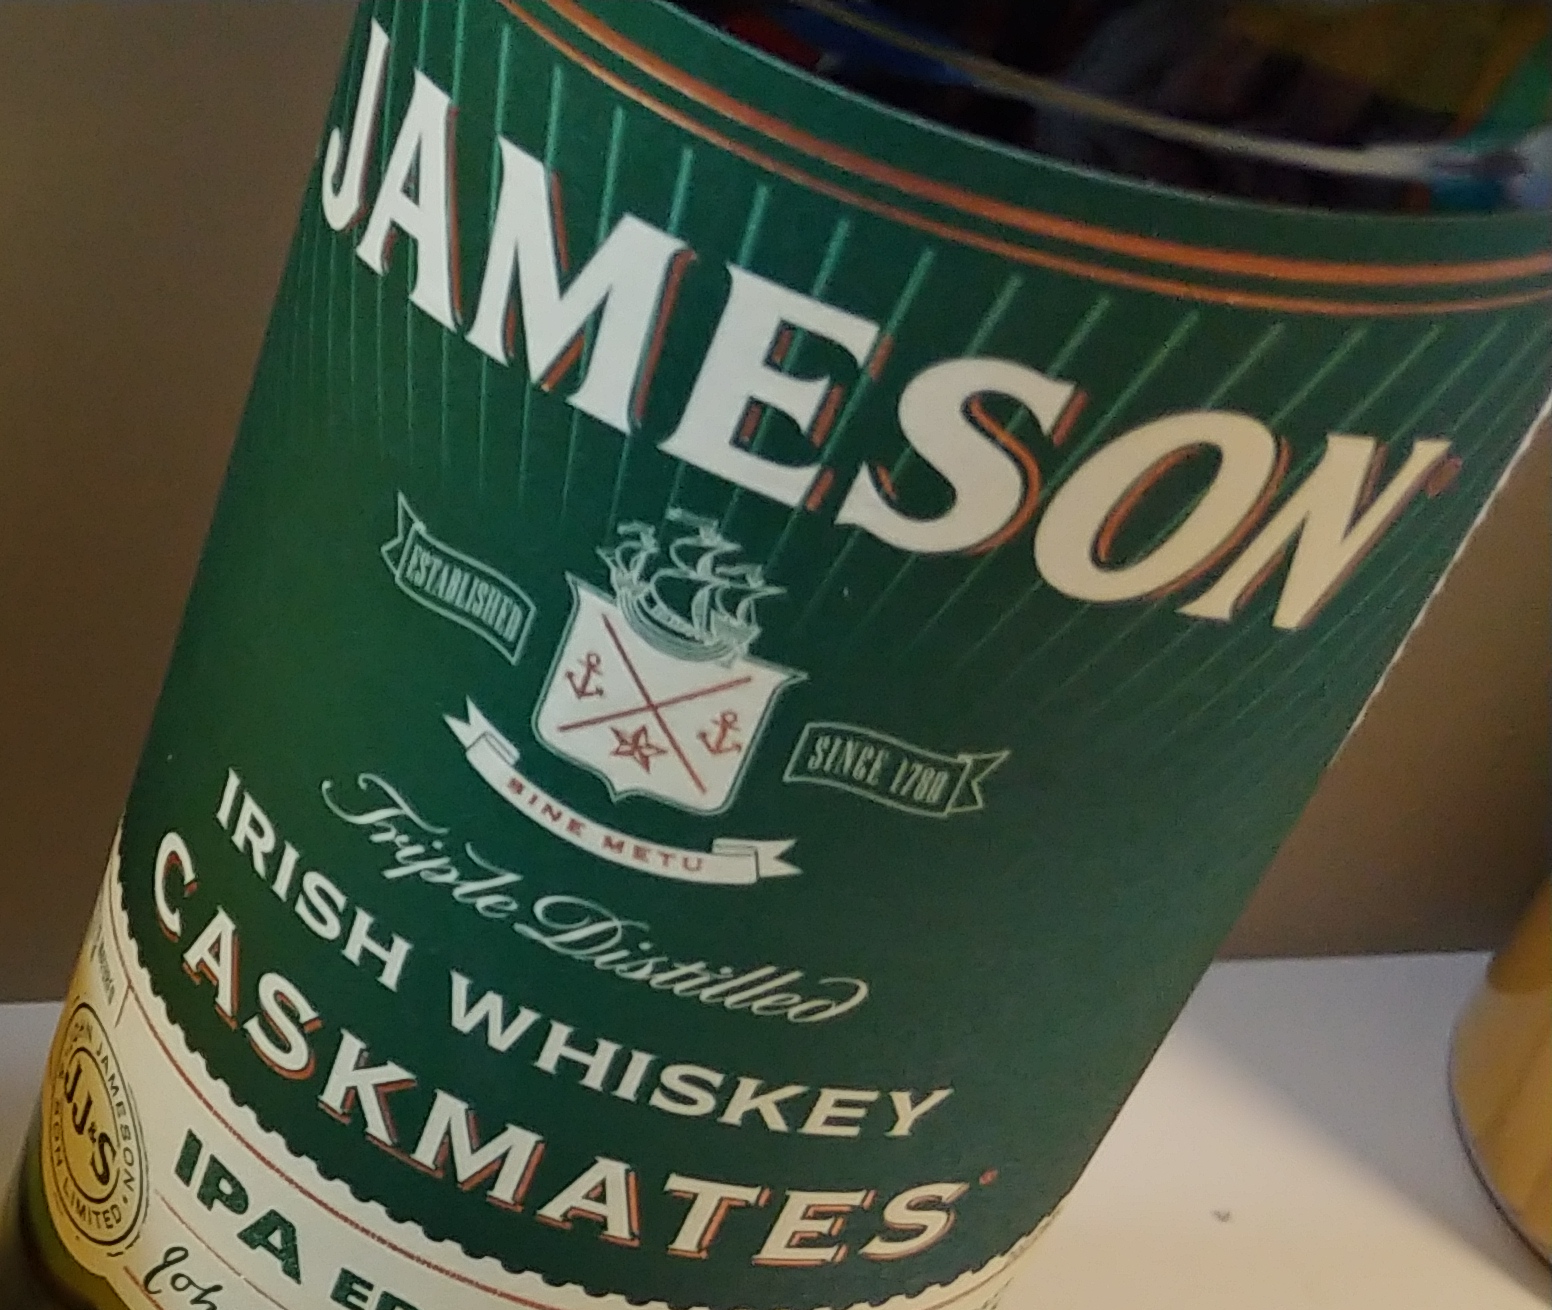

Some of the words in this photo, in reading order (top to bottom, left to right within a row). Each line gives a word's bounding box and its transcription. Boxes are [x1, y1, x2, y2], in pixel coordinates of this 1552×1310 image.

[319, 18, 1458, 632] JAMESON
[405, 543, 525, 644] ESTABLISHED
[508, 776, 586, 838] SINE
[602, 834, 704, 873] METU
[807, 735, 891, 786] SINCE
[889, 757, 950, 804] 1780
[212, 767, 413, 993] IRISH
[446, 968, 954, 1139] WHISKEY
[321, 771, 522, 918] Triple
[514, 894, 870, 1024] Distilled
[153, 831, 972, 1268] CASKMATES
[62, 1177, 123, 1230] LIMITED
[172, 1127, 304, 1285] IPA
